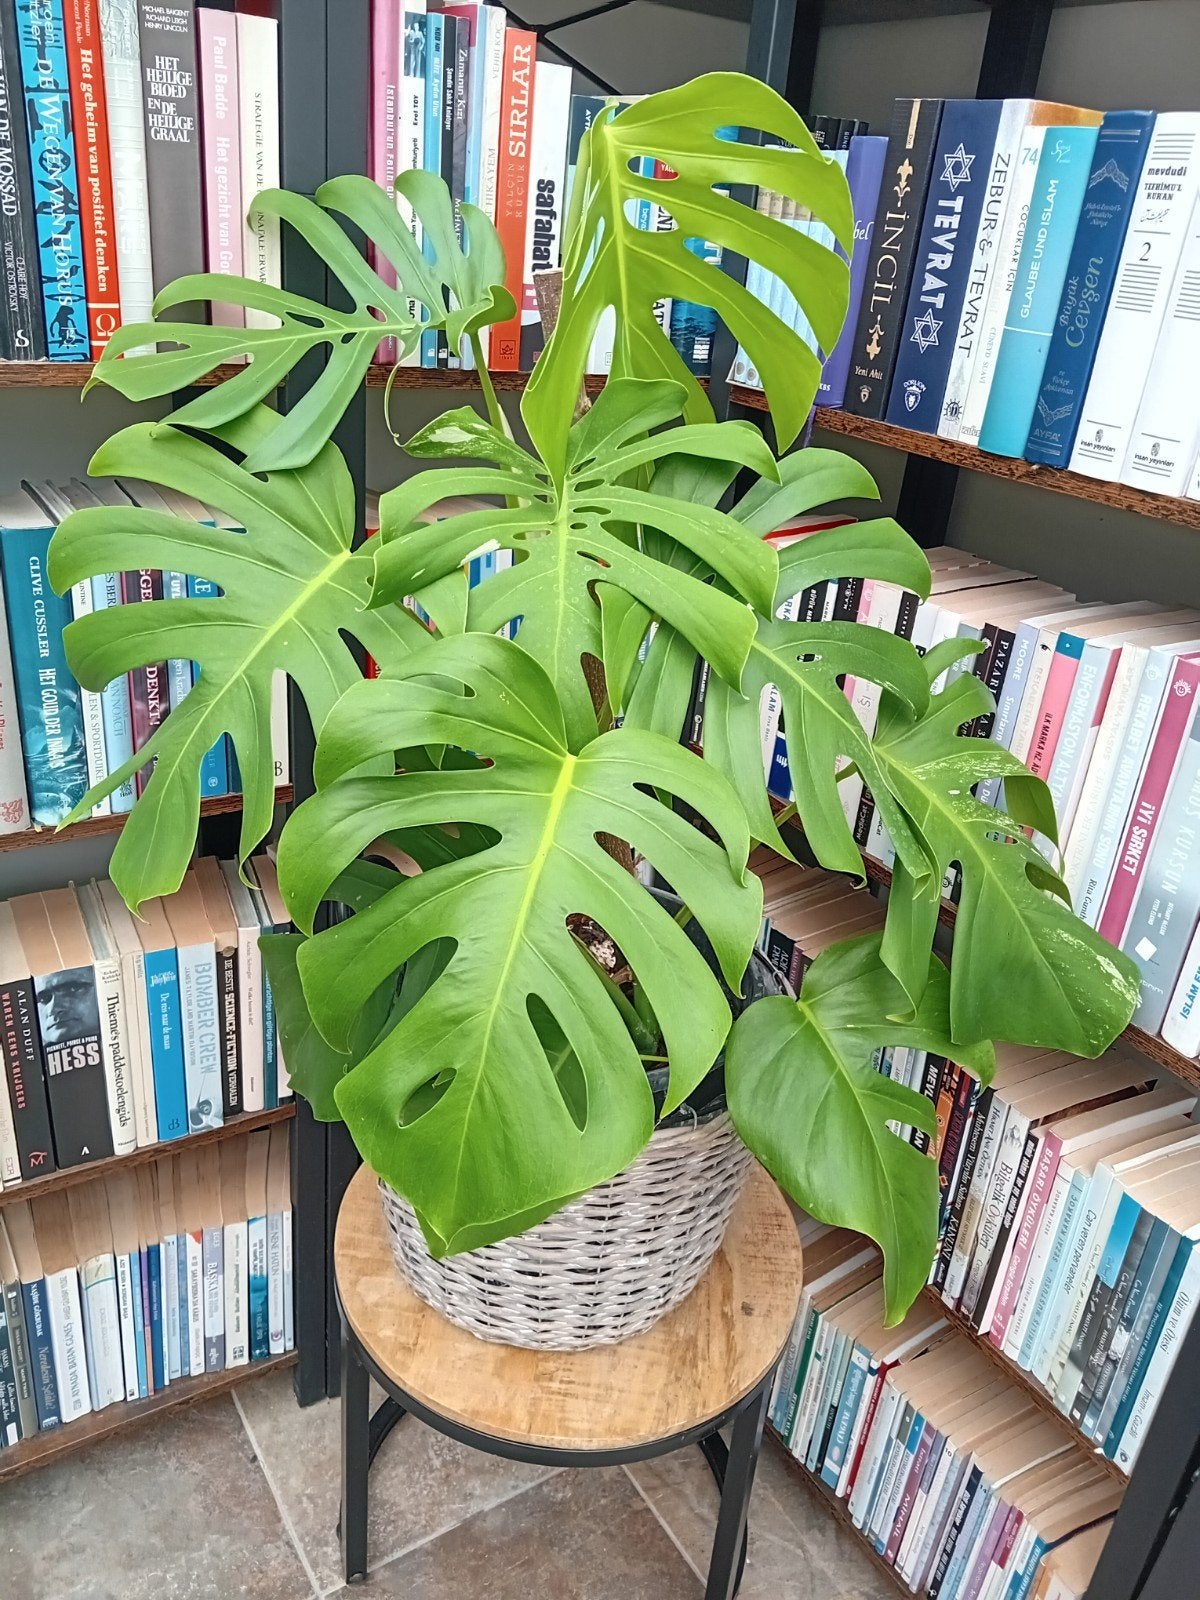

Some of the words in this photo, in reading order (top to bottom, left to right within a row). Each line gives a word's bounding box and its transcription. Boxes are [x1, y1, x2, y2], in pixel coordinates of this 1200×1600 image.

[144, 21, 164, 29] HENRY
[164, 23, 188, 32] LINCOLN
[434, 27, 442, 42] KOD
[80, 48, 94, 79] Het
[155, 55, 180, 69] HET
[213, 35, 229, 72] Paul
[37, 58, 54, 86] DE
[146, 67, 193, 85] HEILIGE
[457, 48, 469, 97] Zamanın
[148, 97, 161, 111] EN
[161, 101, 177, 116] DE
[151, 83, 187, 98] BLOED
[214, 73, 229, 120] Badde
[412, 94, 420, 109] TOY
[509, 44, 532, 158] SIRLAR
[82, 81, 98, 146] geheim
[149, 114, 194, 130] HEILIGE
[253, 91, 263, 148] STRATEGIE
[456, 99, 467, 121] Kızı
[40, 90, 63, 180] WEGEN
[151, 126, 191, 144] GRAAL
[215, 136, 231, 163] Het
[87, 145, 101, 175] van
[255, 150, 264, 171] VAN
[1147, 166, 1187, 179] mevdudi
[0, 146, 18, 217] MOSSAD
[213, 165, 233, 220] gezicht
[255, 172, 264, 187] DE
[505, 162, 516, 217] YALÇIN
[515, 163, 527, 219] KÜÇÜK
[982, 151, 1012, 233] ZEBUR
[50, 186, 66, 230] VAN
[88, 176, 107, 237] positief
[1040, 179, 1060, 227] ISLAM
[219, 220, 232, 249] van
[532, 178, 555, 274] safahat
[1010, 204, 1031, 264] ÇOCUKLAR
[1032, 227, 1049, 259] UND
[4, 241, 14, 268] VICTOR
[869, 211, 910, 314] İNCİL
[919, 194, 965, 311] TEVRAT
[977, 237, 993, 257] &
[1139, 240, 1152, 262] 2
[16, 256, 27, 281] CLAIRE
[52, 229, 74, 307] HORUS
[95, 237, 110, 293] denken
[8, 269, 20, 313] OSTROVSKY
[18, 282, 29, 300] HOY
[1019, 262, 1041, 320] GLAUBE
[1058, 275, 1080, 328] Büyük
[1065, 256, 1104, 348] Cevşen
[957, 263, 989, 359] TEVRAT
[853, 365, 868, 379] Yeni
[1134, 452, 1153, 464] insan
[29, 555, 44, 597] CLIVE
[807, 589, 818, 610] BÜYÜK
[34, 599, 51, 658] CUSSLER
[40, 668, 57, 686] HET
[1012, 639, 1031, 681] MOORE
[41, 688, 60, 716] GOUD
[146, 665, 160, 727] DENKT!
[1060, 664, 1098, 760] ENFORMASYON
[45, 717, 62, 736] DER
[1036, 724, 1052, 751] MARKA
[91, 722, 104, 782] SPORTDUIKE
[856, 805, 869, 841] MediaCat
[1121, 825, 1148, 876] ŞİRKET
[1086, 878, 1099, 895] Rita
[1078, 896, 1095, 921] Gunth
[224, 959, 234, 970] DE
[225, 970, 234, 991] BESTE
[17, 989, 30, 1024] ALAN
[160, 992, 170, 1003] De
[160, 1003, 171, 1013] reis
[193, 962, 215, 1028] BOMBER
[0, 991, 13, 1027] WAREN
[7, 1030, 19, 1057] EENS
[106, 991, 120, 1041] Thieme's
[161, 1013, 171, 1026] naar
[162, 1026, 173, 1035] de
[226, 991, 239, 1071] SCIENCE-FICTION
[22, 1027, 35, 1062] DUFF
[47, 1042, 100, 1077] HESS
[163, 1035, 172, 1050] maan
[199, 1031, 218, 1074] CREW
[111, 1041, 126, 1128] paddestoelengids
[228, 1071, 238, 1107] VERHALEN
[991, 1160, 1014, 1206] Bilgelik
[1035, 1147, 1054, 1190] BAŞARI
[980, 1204, 1004, 1252] Öyküleri
[1018, 1192, 1042, 1249] ÖYKÜLERİ
[1084, 1209, 1098, 1227] Can
[1075, 1226, 1091, 1251] veren
[1062, 1248, 1085, 1296] pervaneler
[1173, 1291, 1189, 1315] Ölüm
[1168, 1315, 1178, 1328] ve
[1160, 1328, 1179, 1355] Ötesi
[37, 1345, 53, 1384] Neredesin
[944, 1447, 953, 1458] 10
